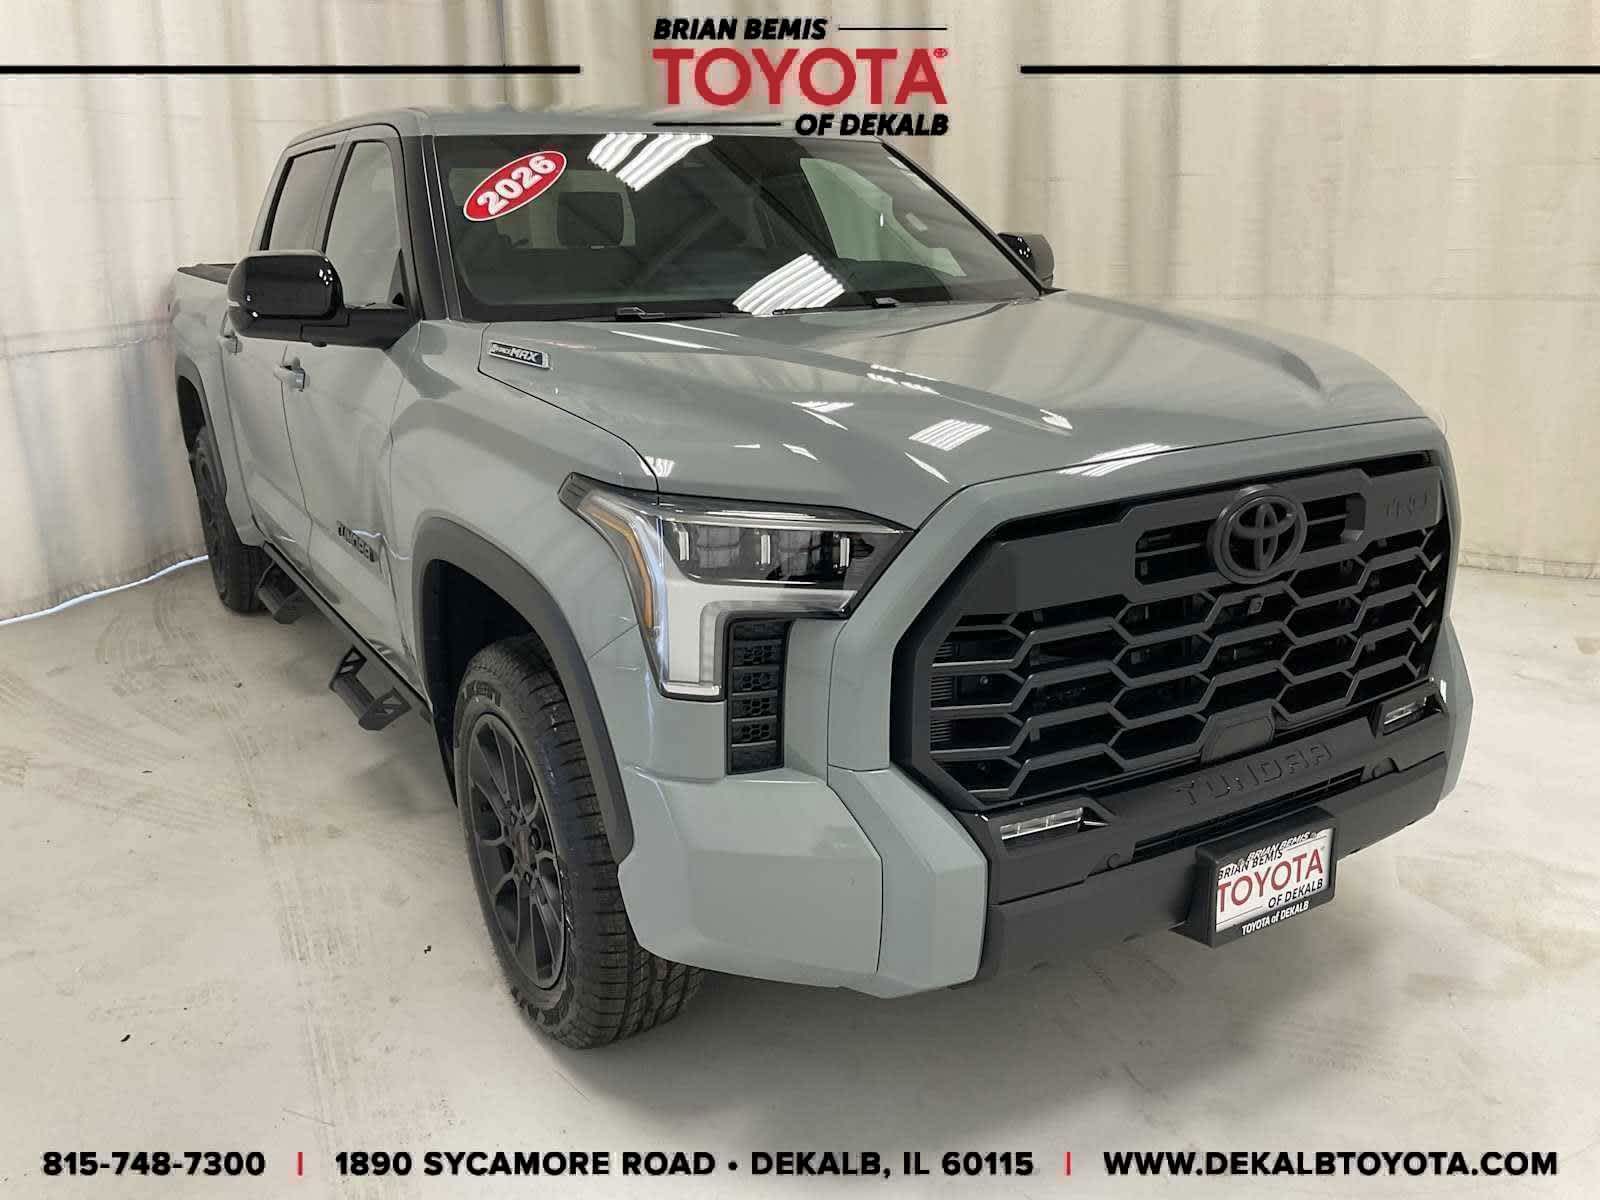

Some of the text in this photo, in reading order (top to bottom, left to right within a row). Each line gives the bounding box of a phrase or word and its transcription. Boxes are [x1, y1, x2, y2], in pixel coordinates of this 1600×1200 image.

[477, 154, 557, 215] 2026
[1218, 849, 1283, 881] BRIAN BEMIS
[1218, 848, 1324, 913] TOYOTA
[1268, 878, 1324, 909] OF DEKALB
[1242, 901, 1310, 936] TOYOTA of DEKALB
